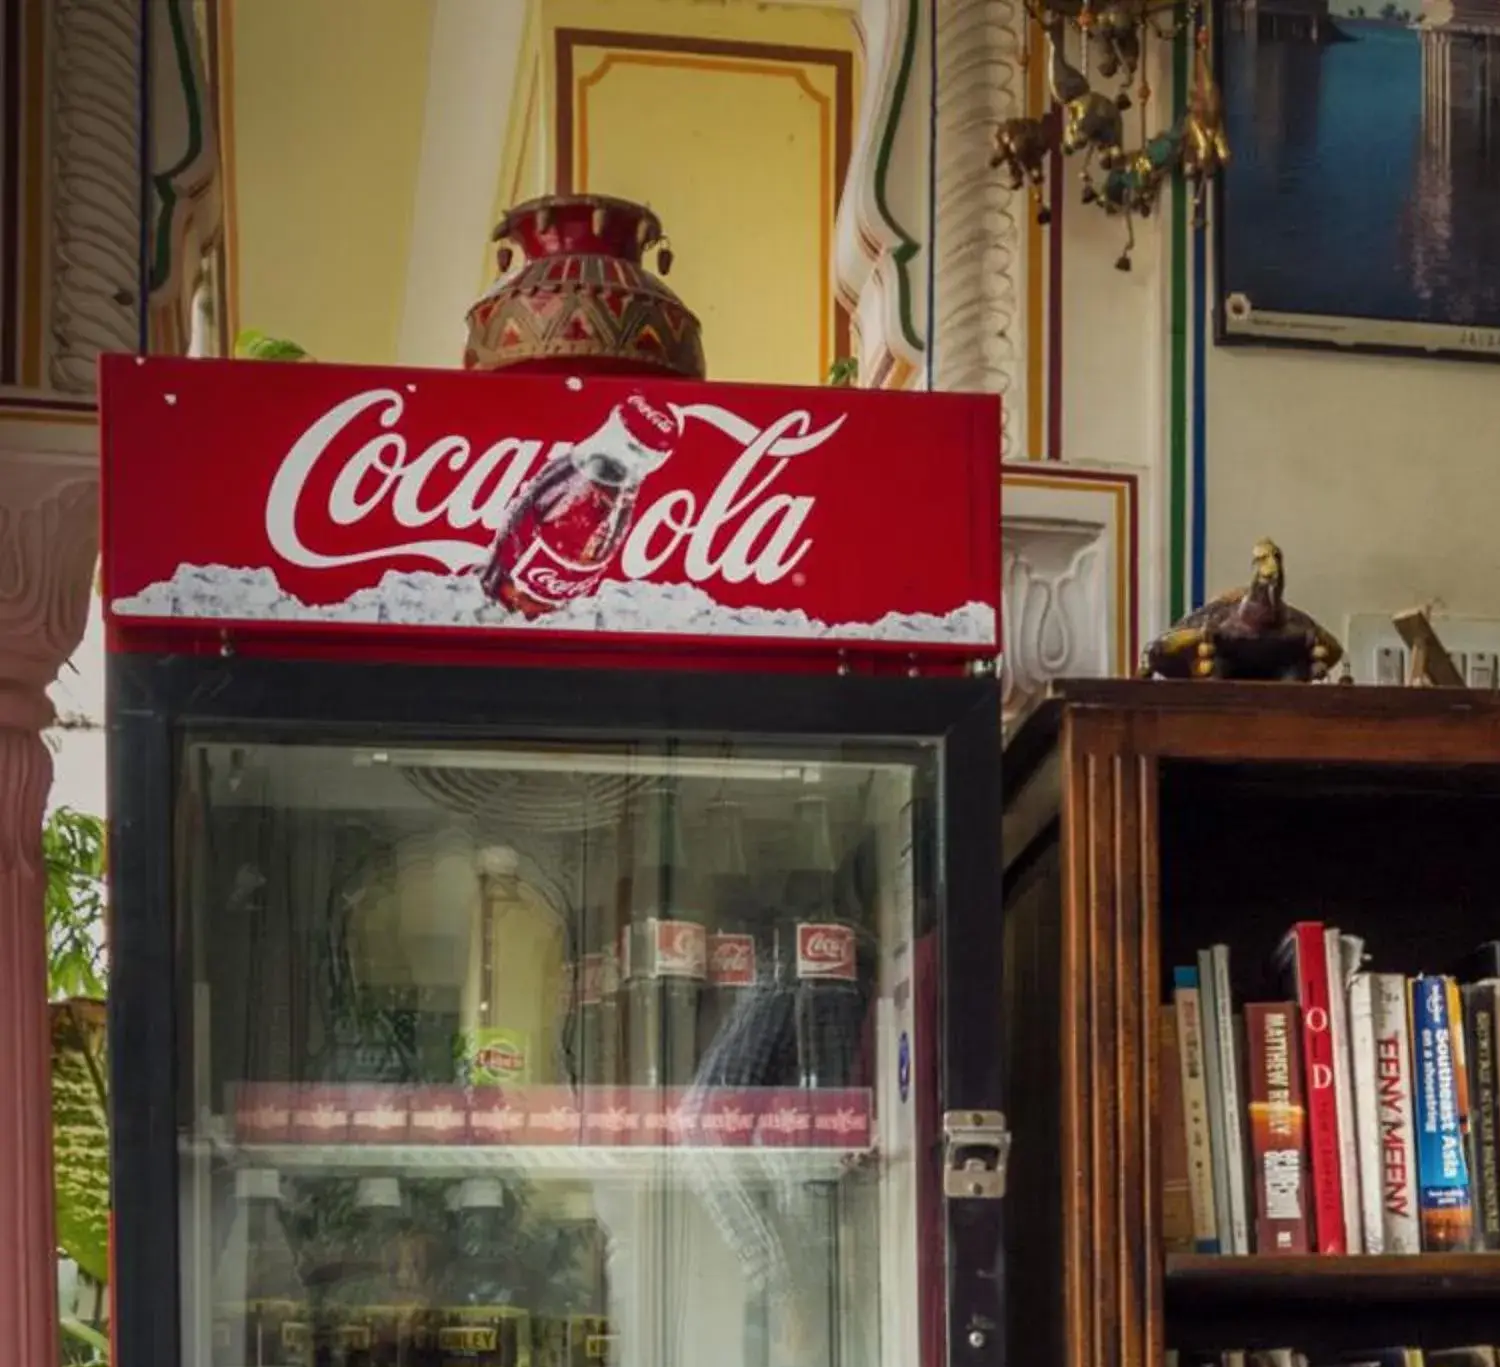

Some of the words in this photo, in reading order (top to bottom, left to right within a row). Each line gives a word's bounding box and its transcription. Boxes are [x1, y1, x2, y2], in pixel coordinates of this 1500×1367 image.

[265, 388, 847, 584] Coca-ola
[1264, 1013, 1289, 1087] MATTHEW
[1376, 1037, 1404, 1112] EENY
[1435, 1029, 1457, 1131] Southeast
[1381, 1120, 1410, 1219] MEENY
[1440, 1136, 1461, 1179] Asia
